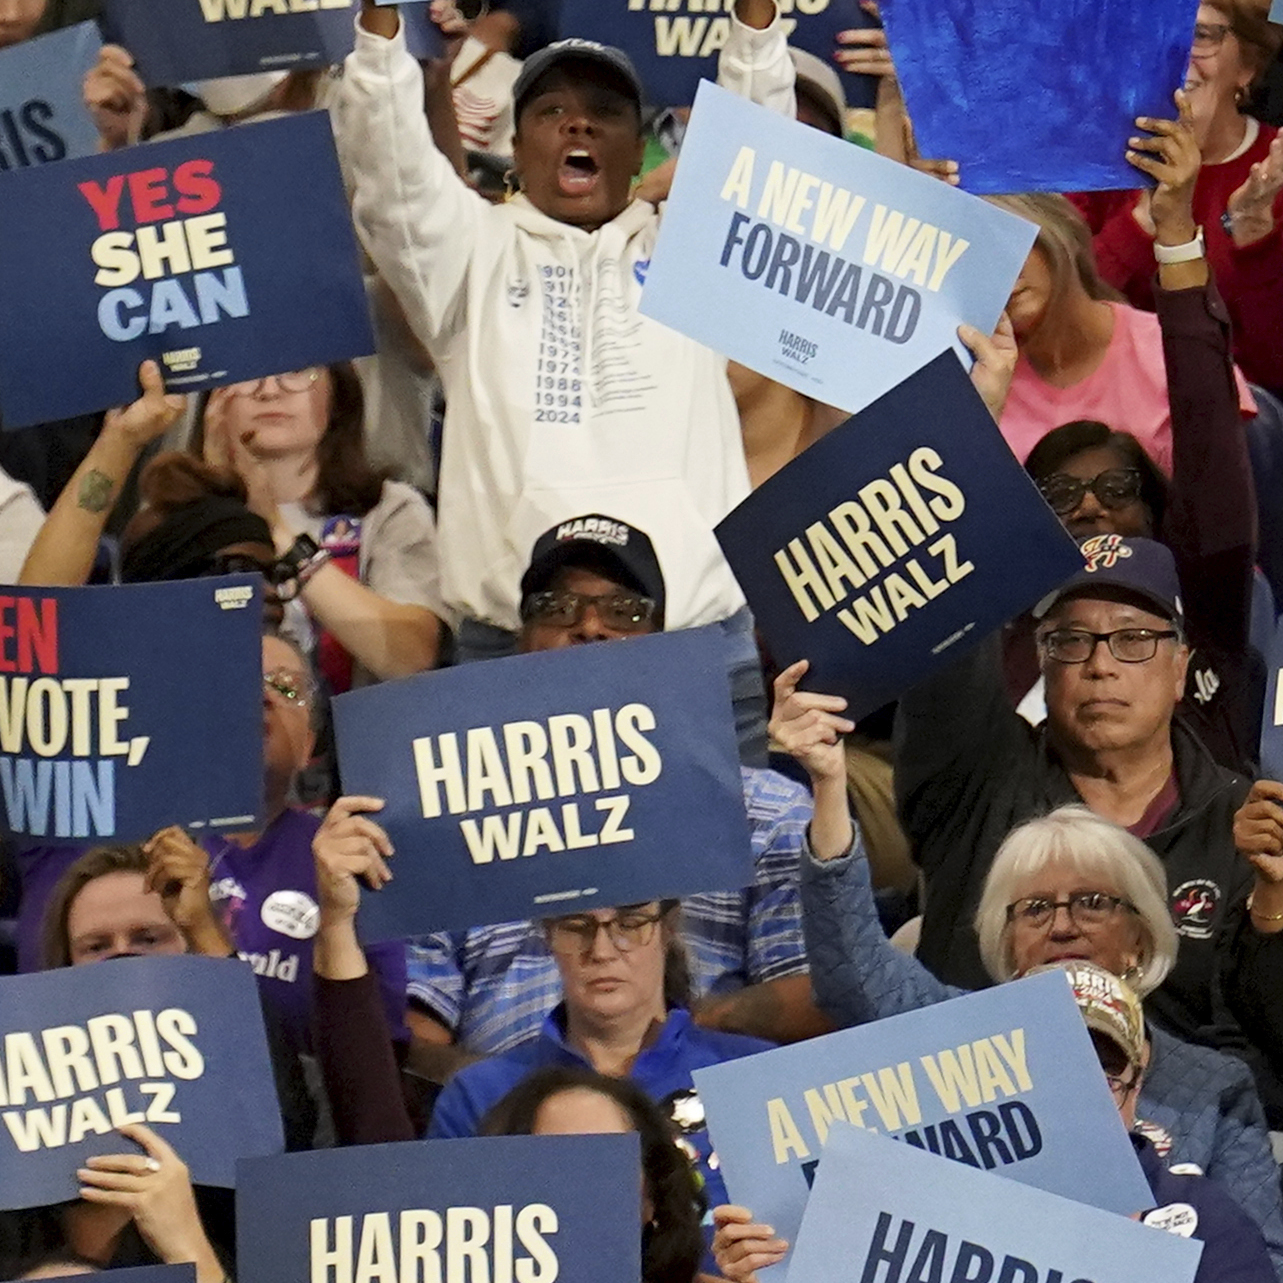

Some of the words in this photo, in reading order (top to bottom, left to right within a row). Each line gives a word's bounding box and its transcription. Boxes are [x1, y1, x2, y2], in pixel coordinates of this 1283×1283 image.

[78, 158, 222, 230] YES
[721, 145, 757, 208] A
[760, 159, 868, 252] NEW
[864, 198, 970, 294] WAY
[90, 212, 235, 288] SHE
[718, 210, 923, 347] FORWARD
[97, 265, 250, 343] CAN
[778, 329, 818, 359] HARRIS
[781, 346, 809, 365] WALZ
[533, 408, 582, 425] 2024
[534, 391, 583, 408] 1994
[773, 446, 967, 623] HARRIS
[836, 533, 975, 646] WALZ
[412, 703, 663, 820] HARRIS
[459, 795, 635, 865] WALZ
[1, 1082, 181, 1152] WALZ
[766, 1098, 810, 1165] A
[803, 1063, 923, 1144] NEW
[922, 1028, 1034, 1115] WAY
[310, 1203, 559, 1283] HARRIS
